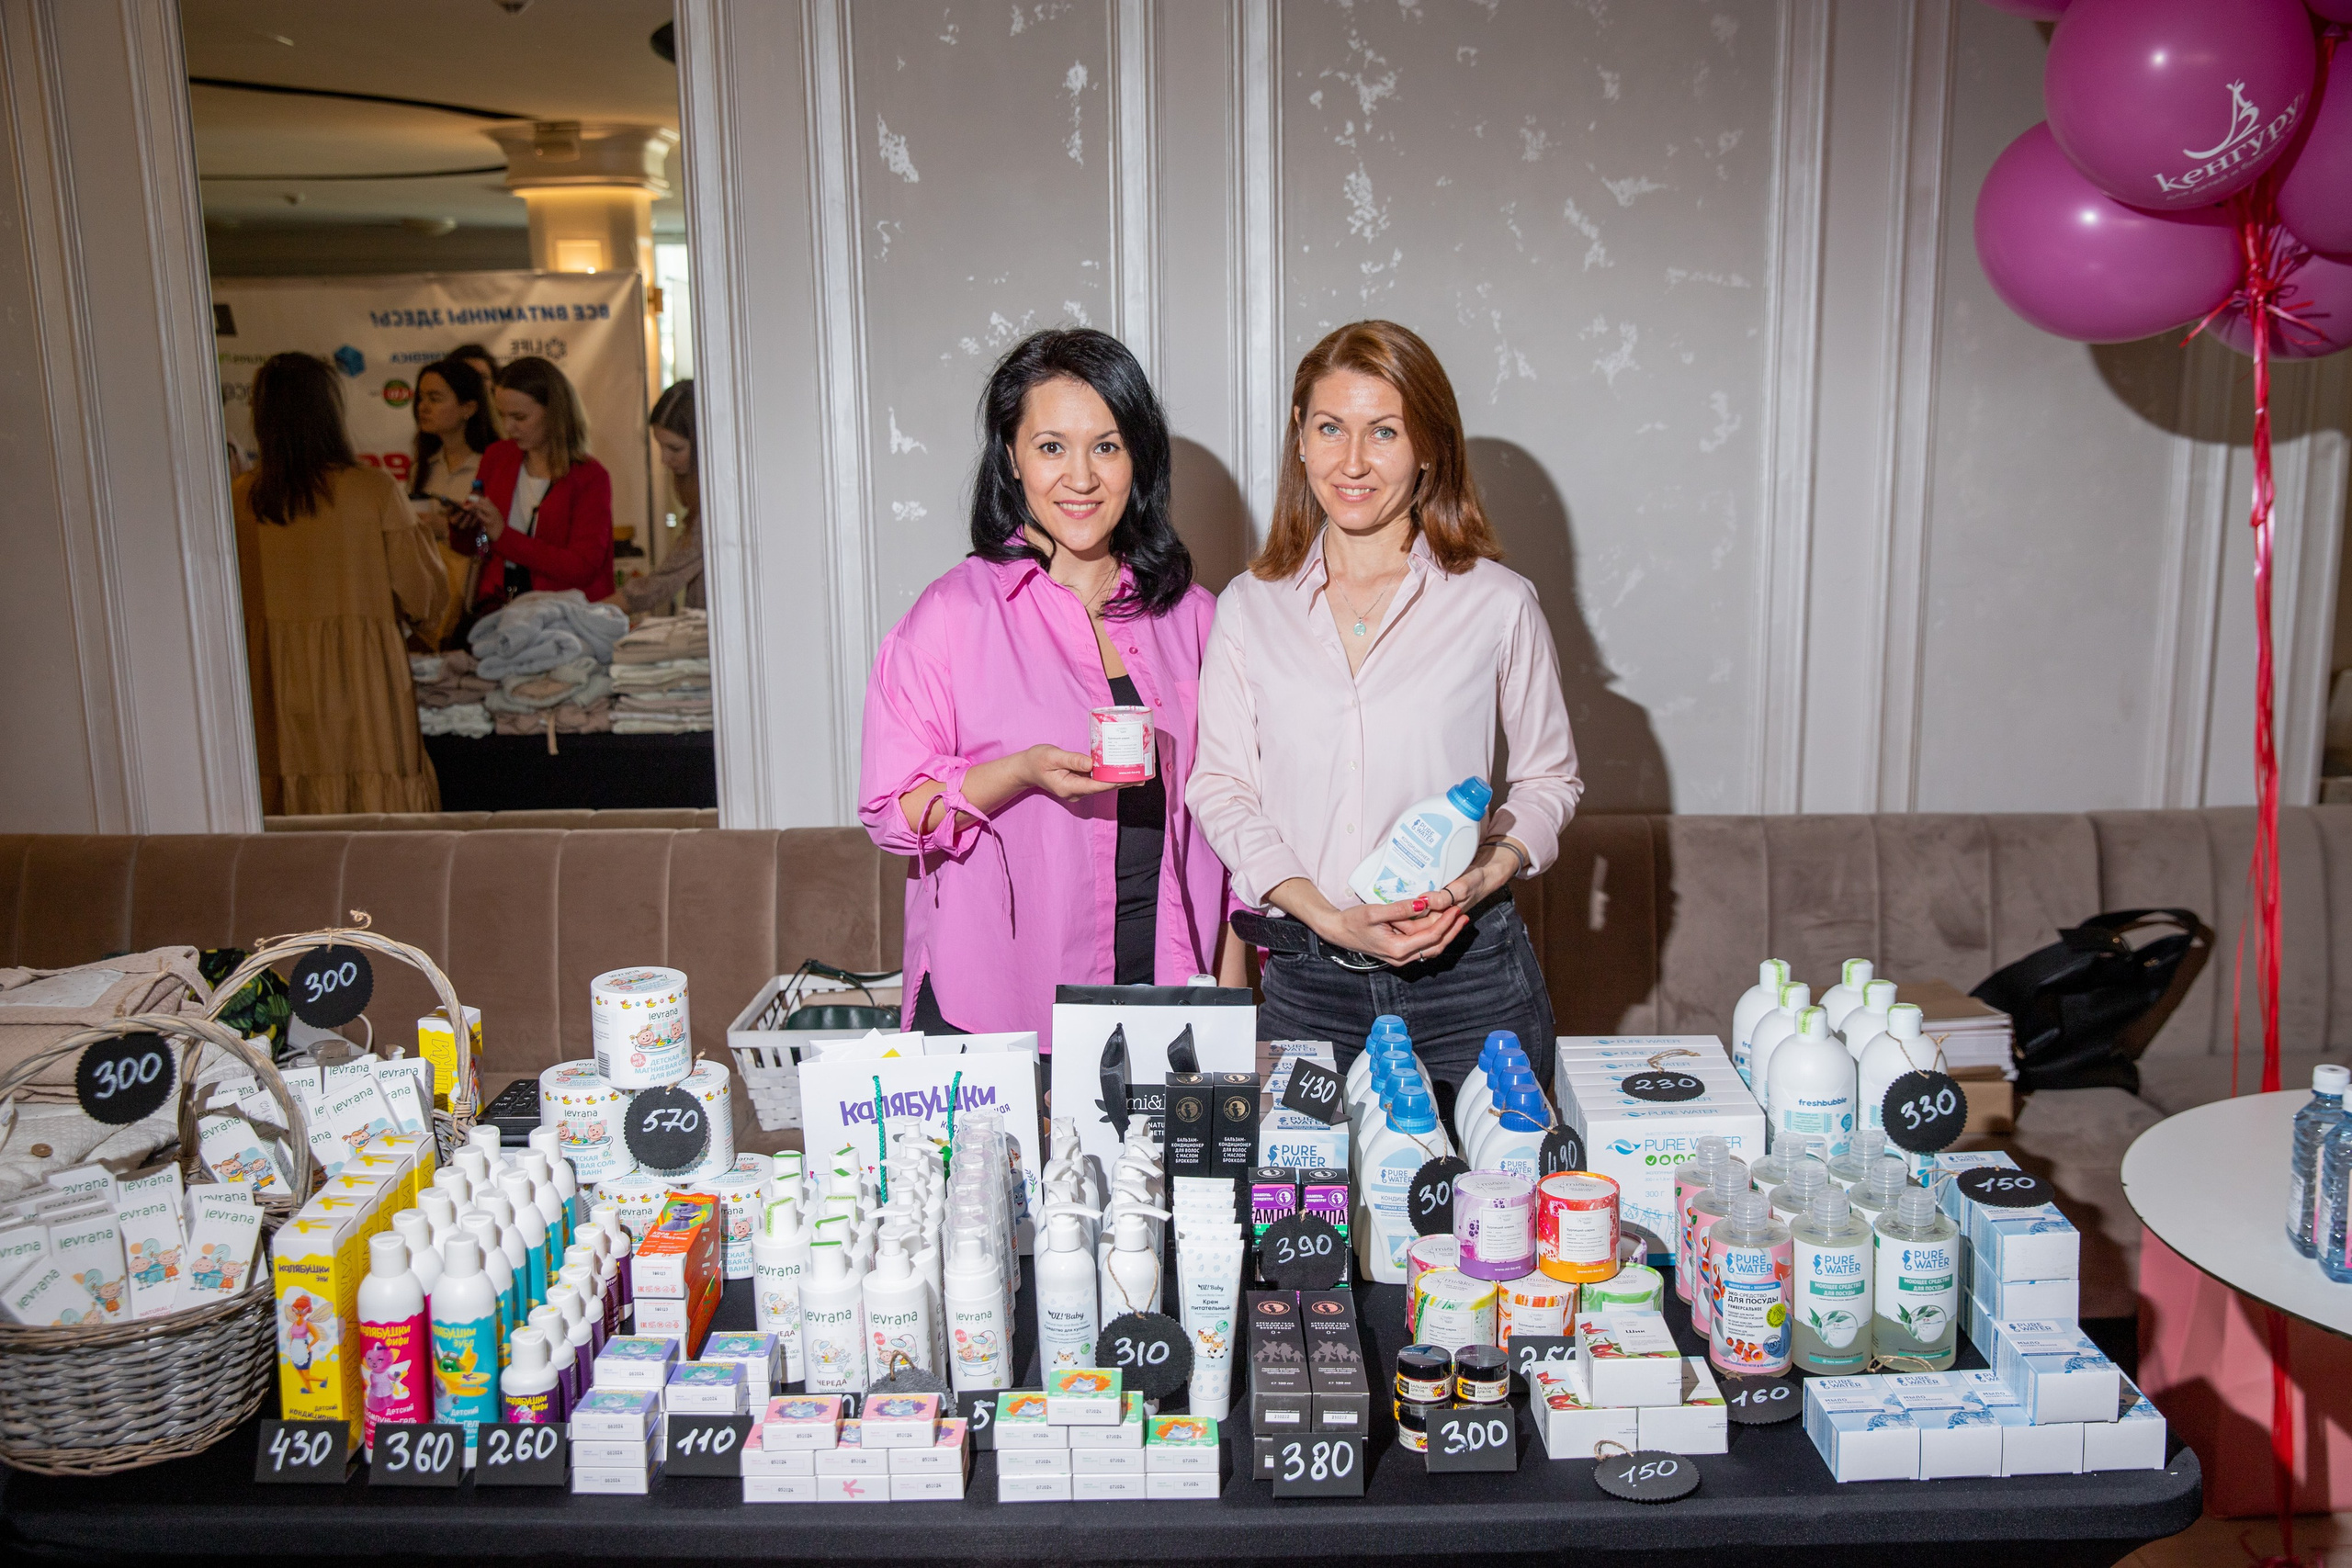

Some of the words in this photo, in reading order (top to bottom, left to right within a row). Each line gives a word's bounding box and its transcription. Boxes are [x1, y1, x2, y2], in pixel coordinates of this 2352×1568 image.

[1417, 827, 1434, 843] WATER
[1419, 822, 1434, 836] PURE
[304, 962, 357, 1004] 300
[649, 1008, 678, 1021] levrana
[650, 1054, 679, 1066] ДЕТСКАЯ
[93, 1052, 164, 1099] 300
[329, 1063, 368, 1076] levrana
[379, 1065, 418, 1079] levrana
[635, 1063, 677, 1074] МАГНИЕВАЯ
[650, 1072, 665, 1081] ДЛЯ
[666, 1068, 683, 1077] ВАНН
[1299, 1070, 1336, 1103] 430
[1634, 1077, 1697, 1091] 230
[333, 1086, 374, 1114] levrana
[1798, 1097, 1848, 1107] freshbubble
[564, 1109, 597, 1118] levrana
[1900, 1088, 1956, 1130] 330
[643, 1109, 698, 1133] 570
[1282, 1145, 1317, 1156] PURE
[1645, 1138, 1685, 1151] PURE
[597, 1159, 616, 1168] СОЛЬ
[1282, 1156, 1326, 1167] WATER
[124, 1173, 174, 1192] levrana
[1974, 1177, 2036, 1192] 150
[1419, 1173, 1463, 1215] 30
[119, 1202, 166, 1222] evrana
[205, 1208, 255, 1224] levrana
[619, 1207, 652, 1216] levrana
[59, 1228, 114, 1249] levrana
[1276, 1235, 1332, 1264] 390
[1914, 1249, 1944, 1259] PURE
[1736, 1254, 1766, 1264] PURE
[1825, 1255, 1855, 1264] PURE
[1914, 1258, 1950, 1269] WATER
[756, 1262, 800, 1277] levrana
[1736, 1263, 1773, 1273] WATER
[1825, 1263, 1860, 1274] WATER
[17, 1268, 61, 1310] levrana
[1815, 1281, 1838, 1290] МОЮЩЕЕ
[1839, 1281, 1861, 1290] СРЕДСТВО
[1746, 1296, 1779, 1305] ПОСУДЫ
[804, 1307, 852, 1324] levrana
[870, 1309, 918, 1325] levrana
[956, 1309, 992, 1321] levrana
[1065, 1312, 1084, 1320] Baby
[1114, 1337, 1170, 1367] 310
[817, 1378, 847, 1387] ЧЕРЕДА
[1732, 1386, 1790, 1406] 160
[676, 1427, 736, 1456] 110
[1441, 1420, 1508, 1453] 300
[270, 1428, 333, 1472] 430
[386, 1431, 454, 1472] 360
[488, 1426, 558, 1465] 260
[1282, 1441, 1353, 1481] 380
[1619, 1460, 1678, 1483] 150
